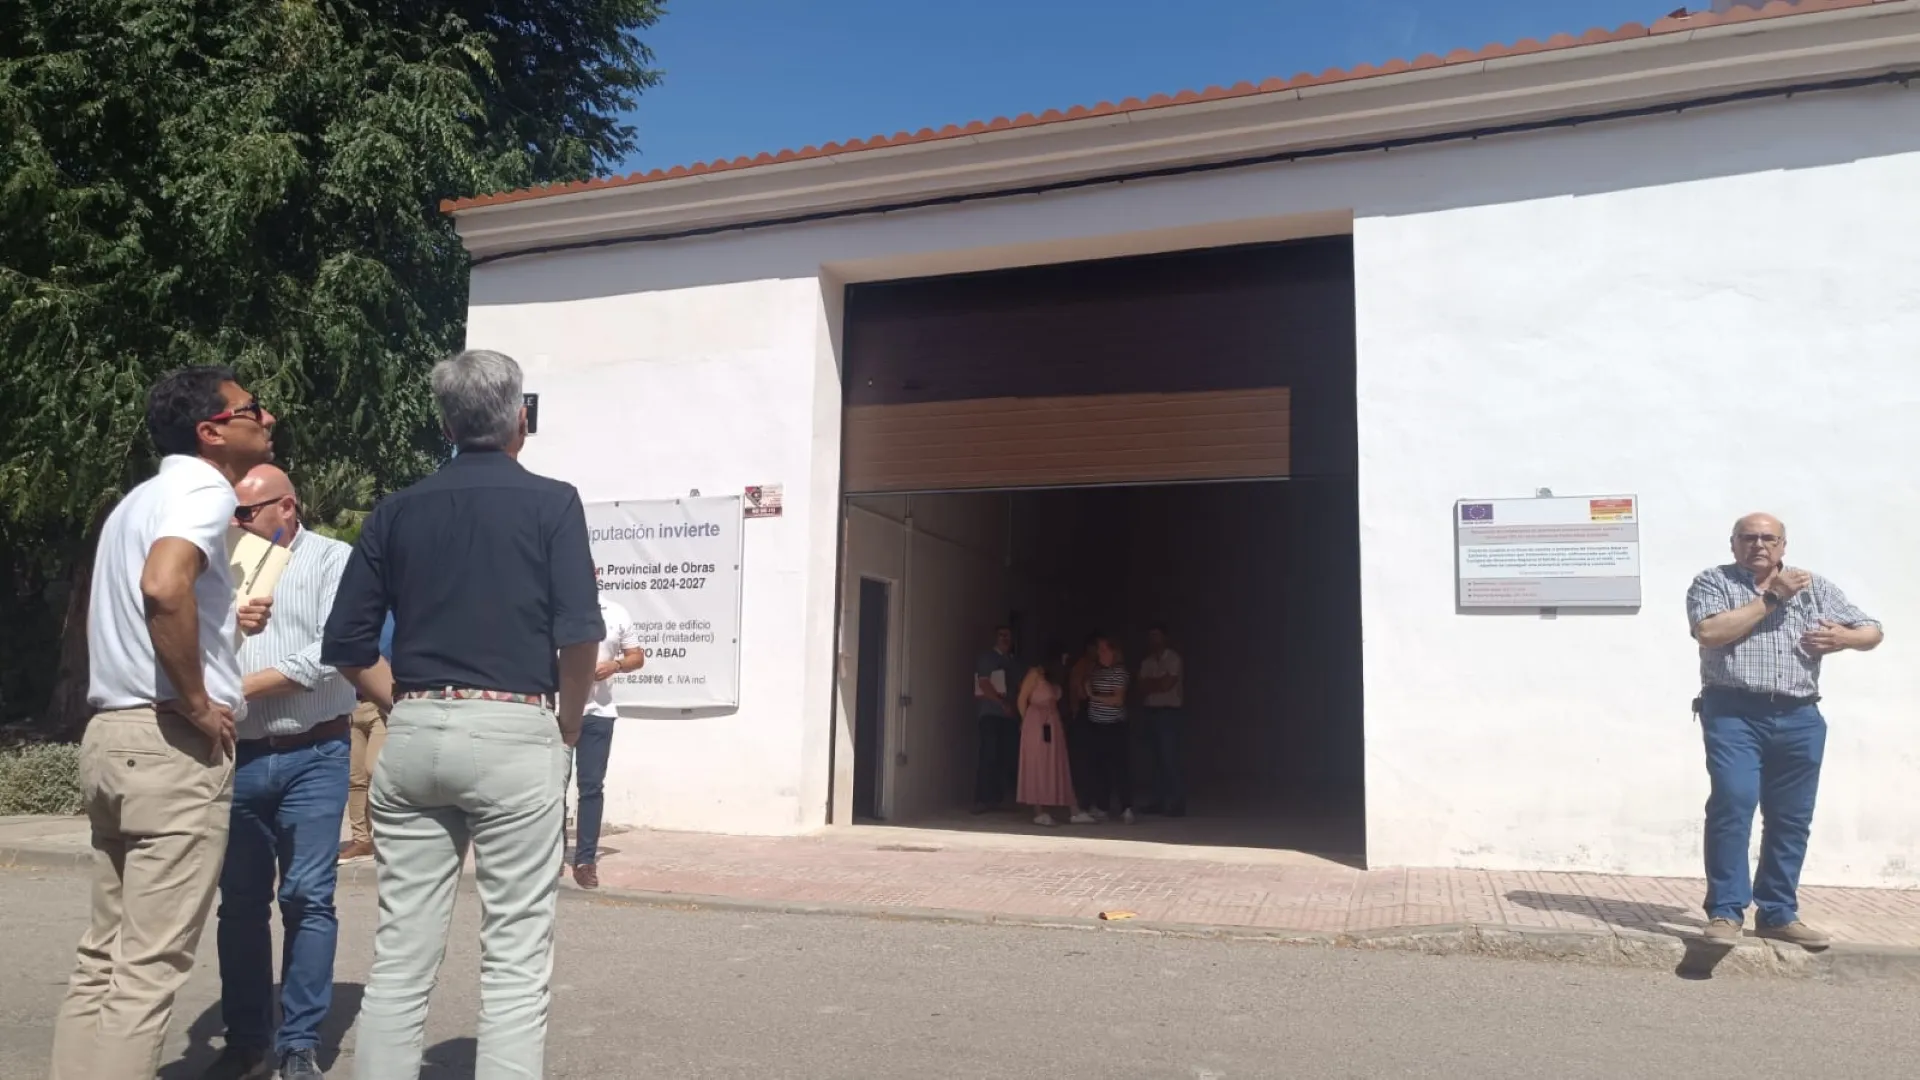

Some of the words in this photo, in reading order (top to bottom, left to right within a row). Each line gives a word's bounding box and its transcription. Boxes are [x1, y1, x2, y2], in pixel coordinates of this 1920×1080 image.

[588, 524, 655, 544] iputación
[659, 522, 720, 538] invierte
[607, 563, 661, 576] Provincial
[664, 562, 678, 574] de
[681, 561, 715, 573] Obras
[597, 579, 647, 591] Servicios
[650, 577, 706, 590] 2024-2027
[665, 620, 677, 631] de
[679, 619, 711, 630] edificio
[637, 631, 660, 644] cipal
[662, 631, 715, 644] (matadero)
[656, 647, 686, 658] ABAD
[677, 674, 690, 685] IVA
